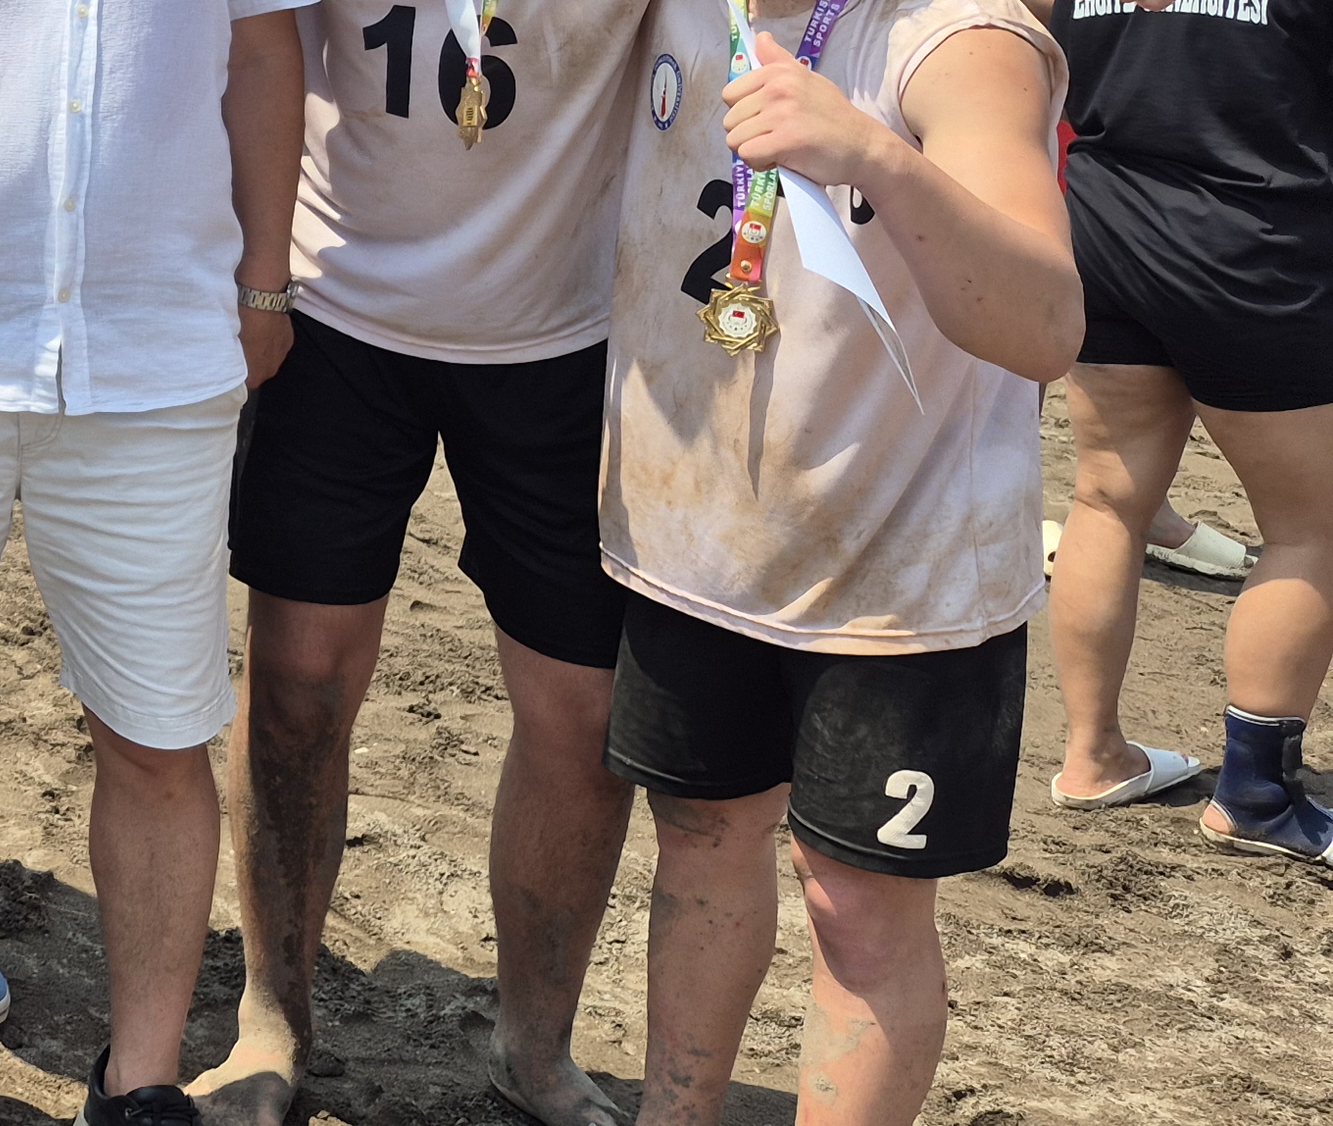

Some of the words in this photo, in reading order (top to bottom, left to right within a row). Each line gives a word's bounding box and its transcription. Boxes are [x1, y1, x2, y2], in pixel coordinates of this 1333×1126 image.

[813, 3, 841, 47] SPORTS
[362, 4, 518, 130] 16
[877, 770, 935, 850] 2
